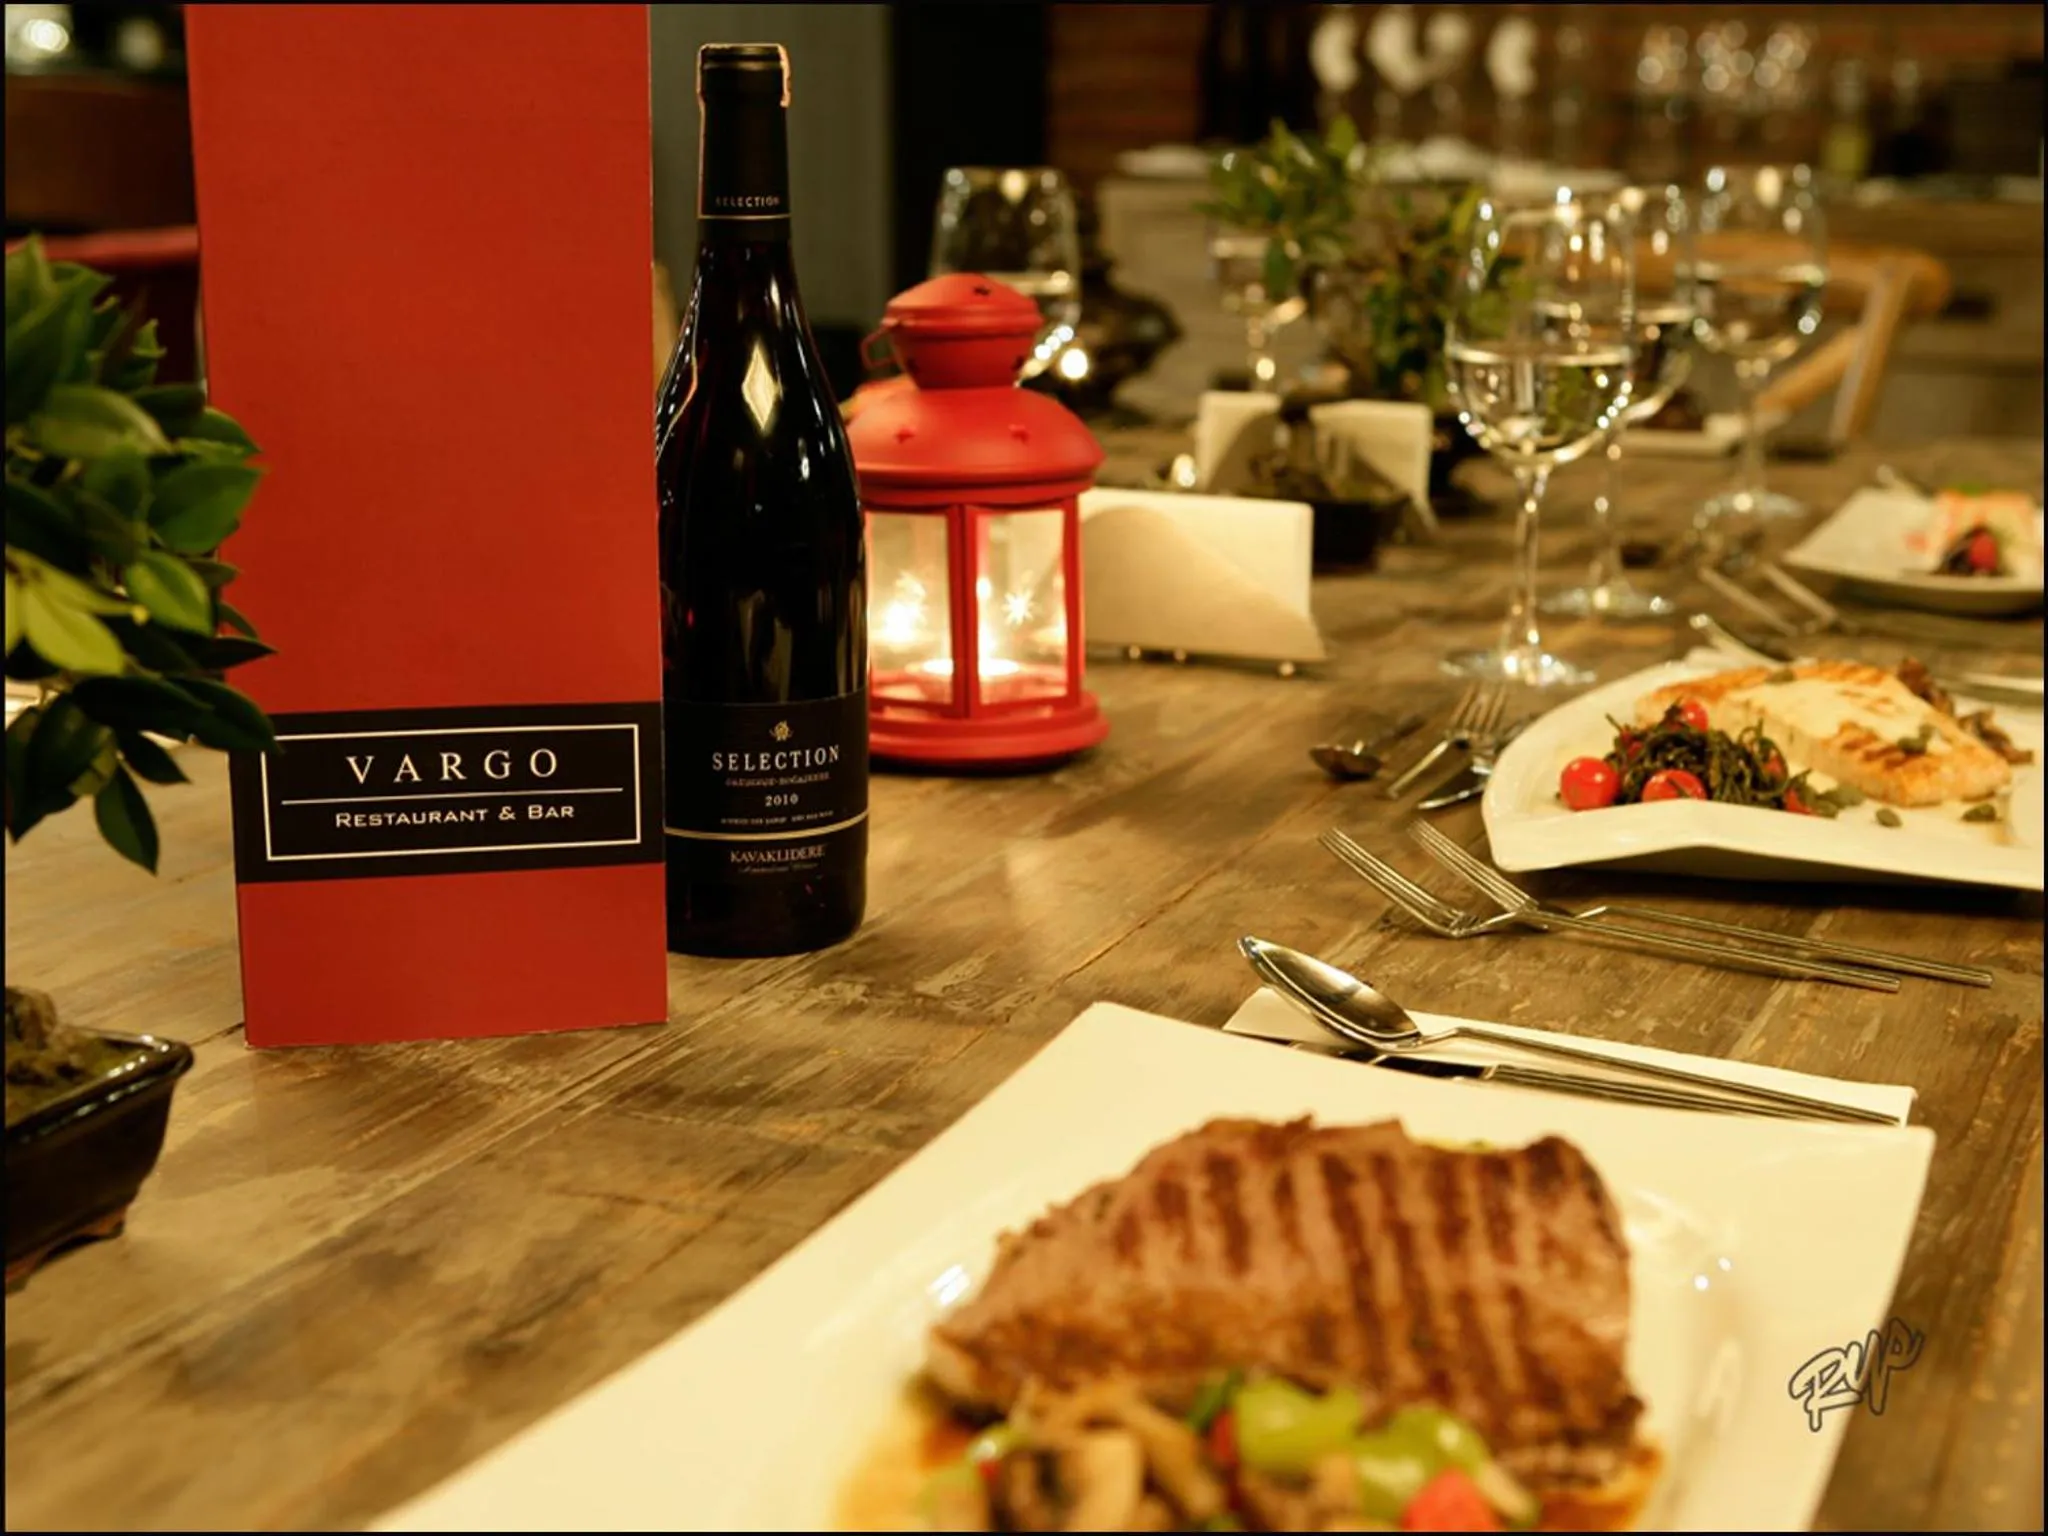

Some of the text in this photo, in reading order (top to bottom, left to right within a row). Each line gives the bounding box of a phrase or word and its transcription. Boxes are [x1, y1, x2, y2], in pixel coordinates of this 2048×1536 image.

[346, 748, 557, 784] VARGO
[712, 744, 839, 772] SELECTION
[765, 793, 799, 807] 2010
[498, 805, 516, 821] &
